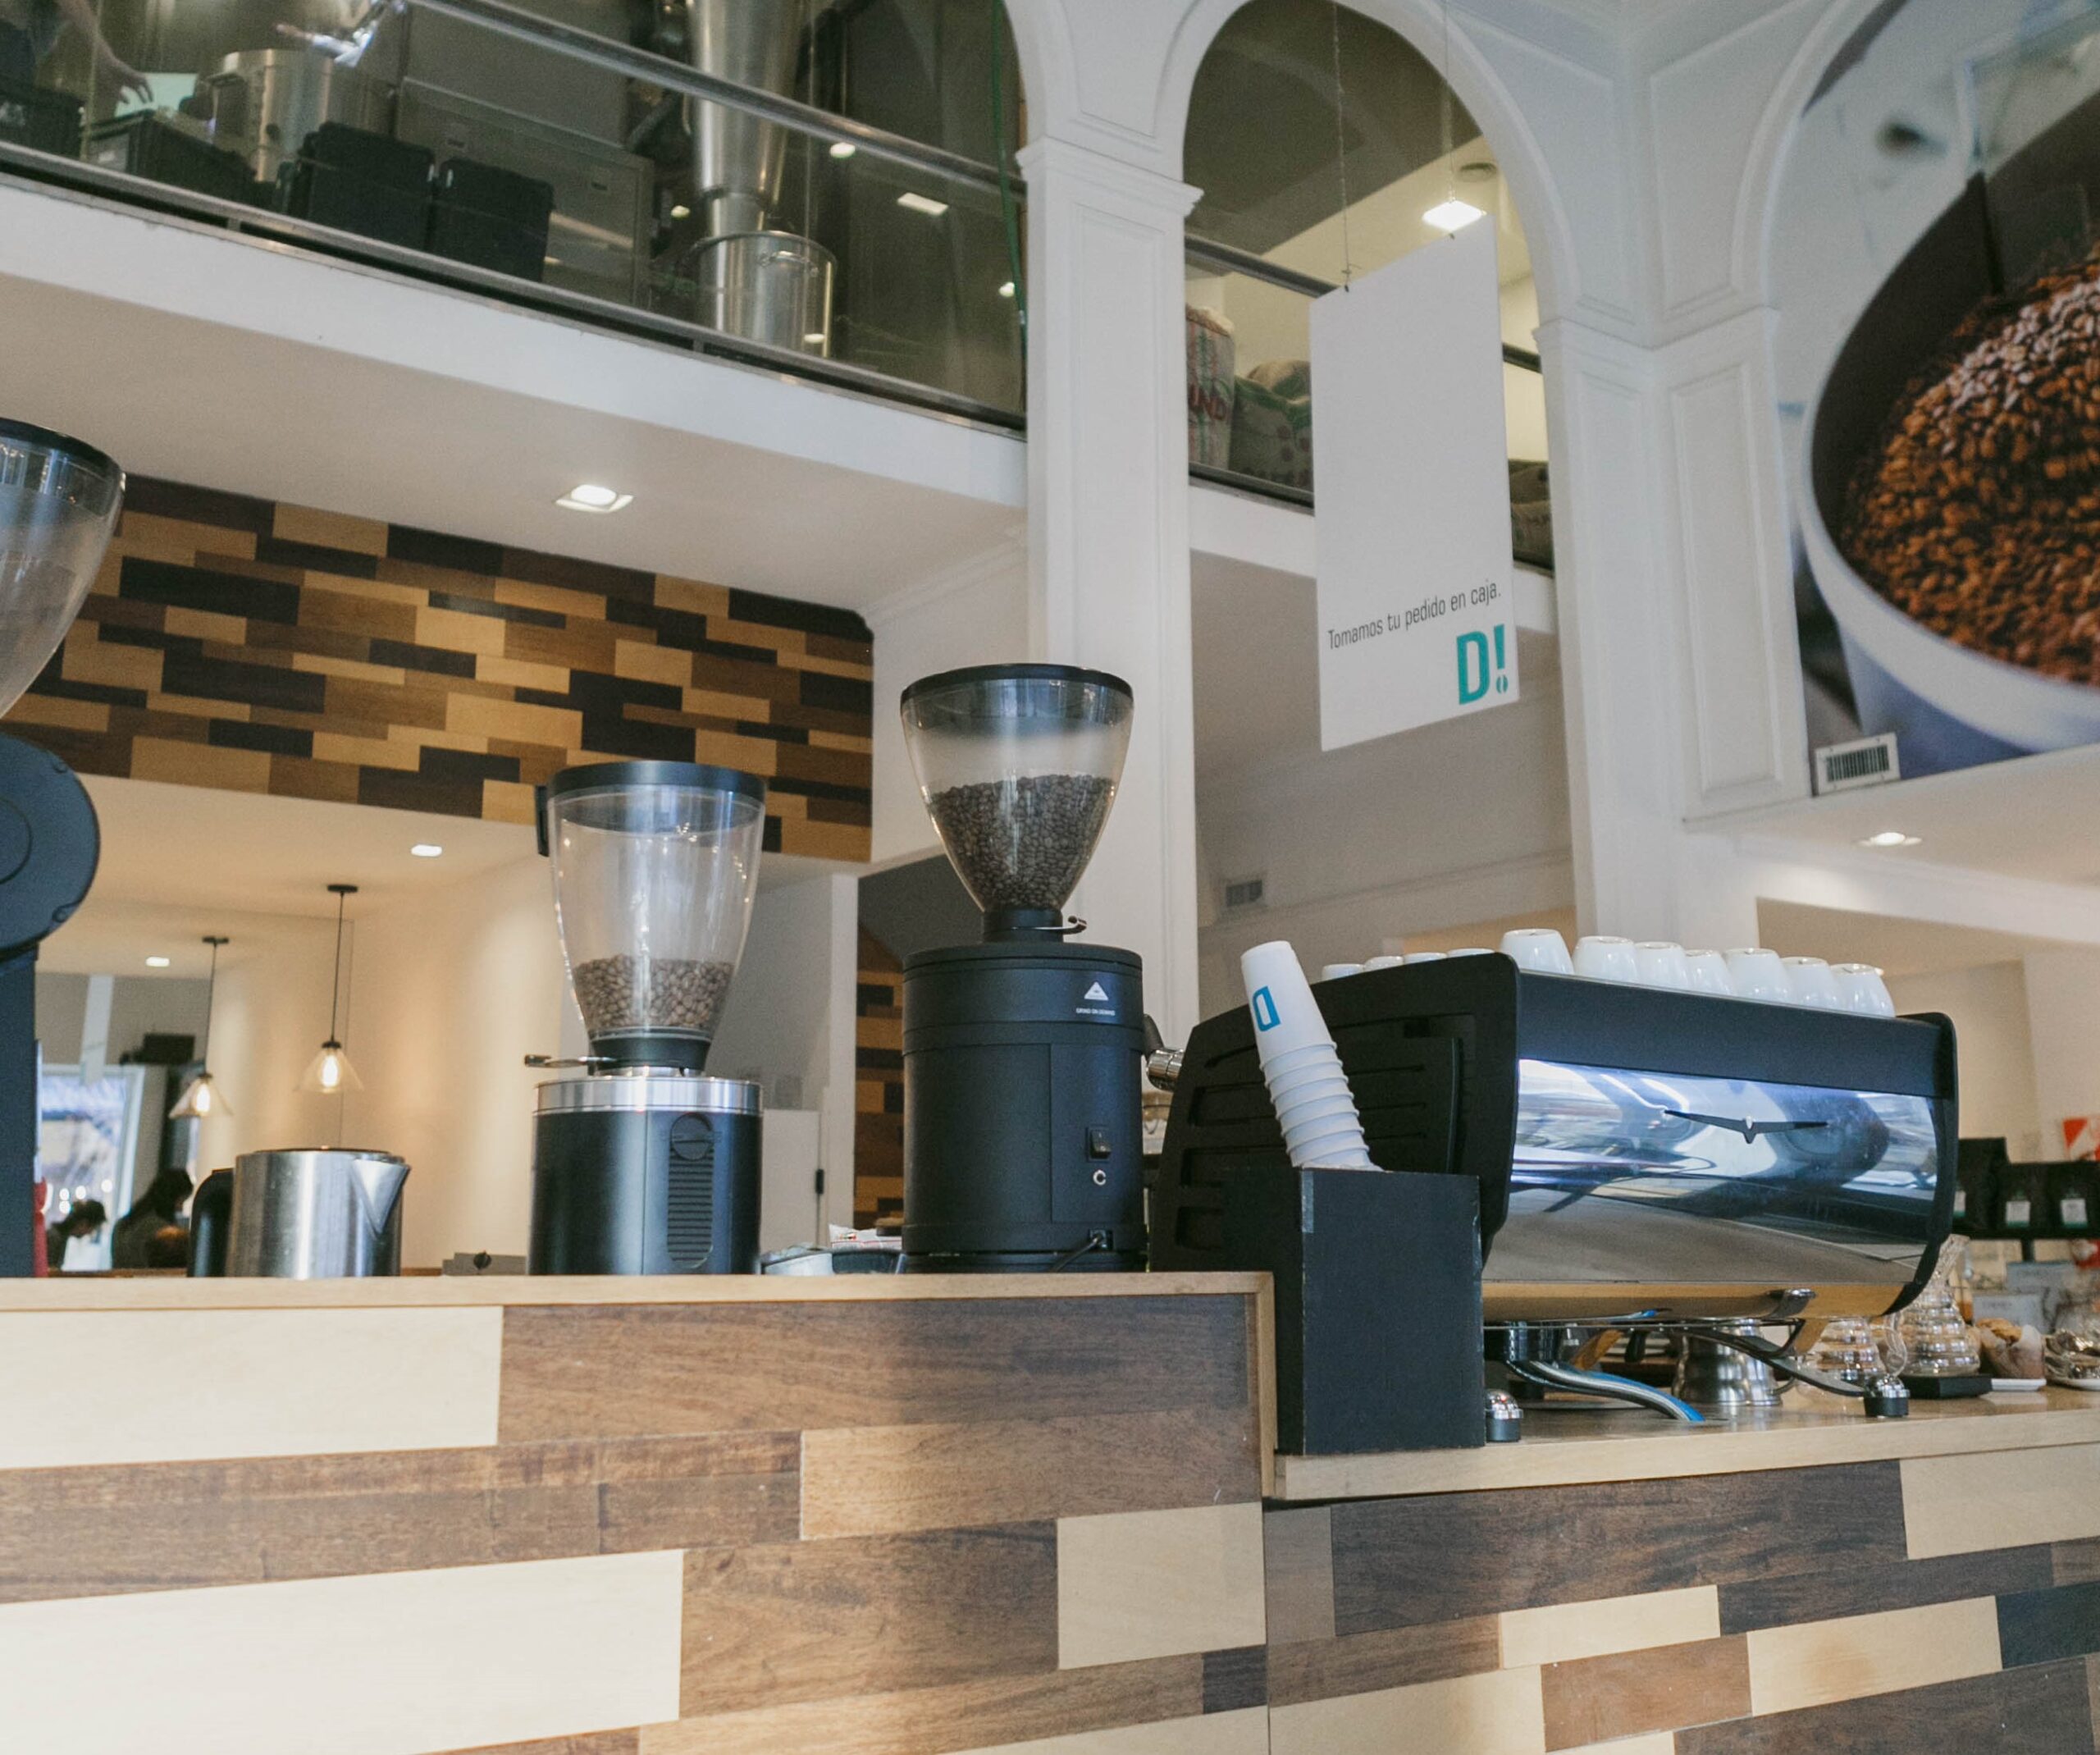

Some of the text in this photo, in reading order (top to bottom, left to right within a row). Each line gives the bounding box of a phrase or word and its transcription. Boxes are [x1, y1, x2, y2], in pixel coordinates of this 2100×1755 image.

[1328, 578, 1501, 650] Tomamos tu pedido en caja.
